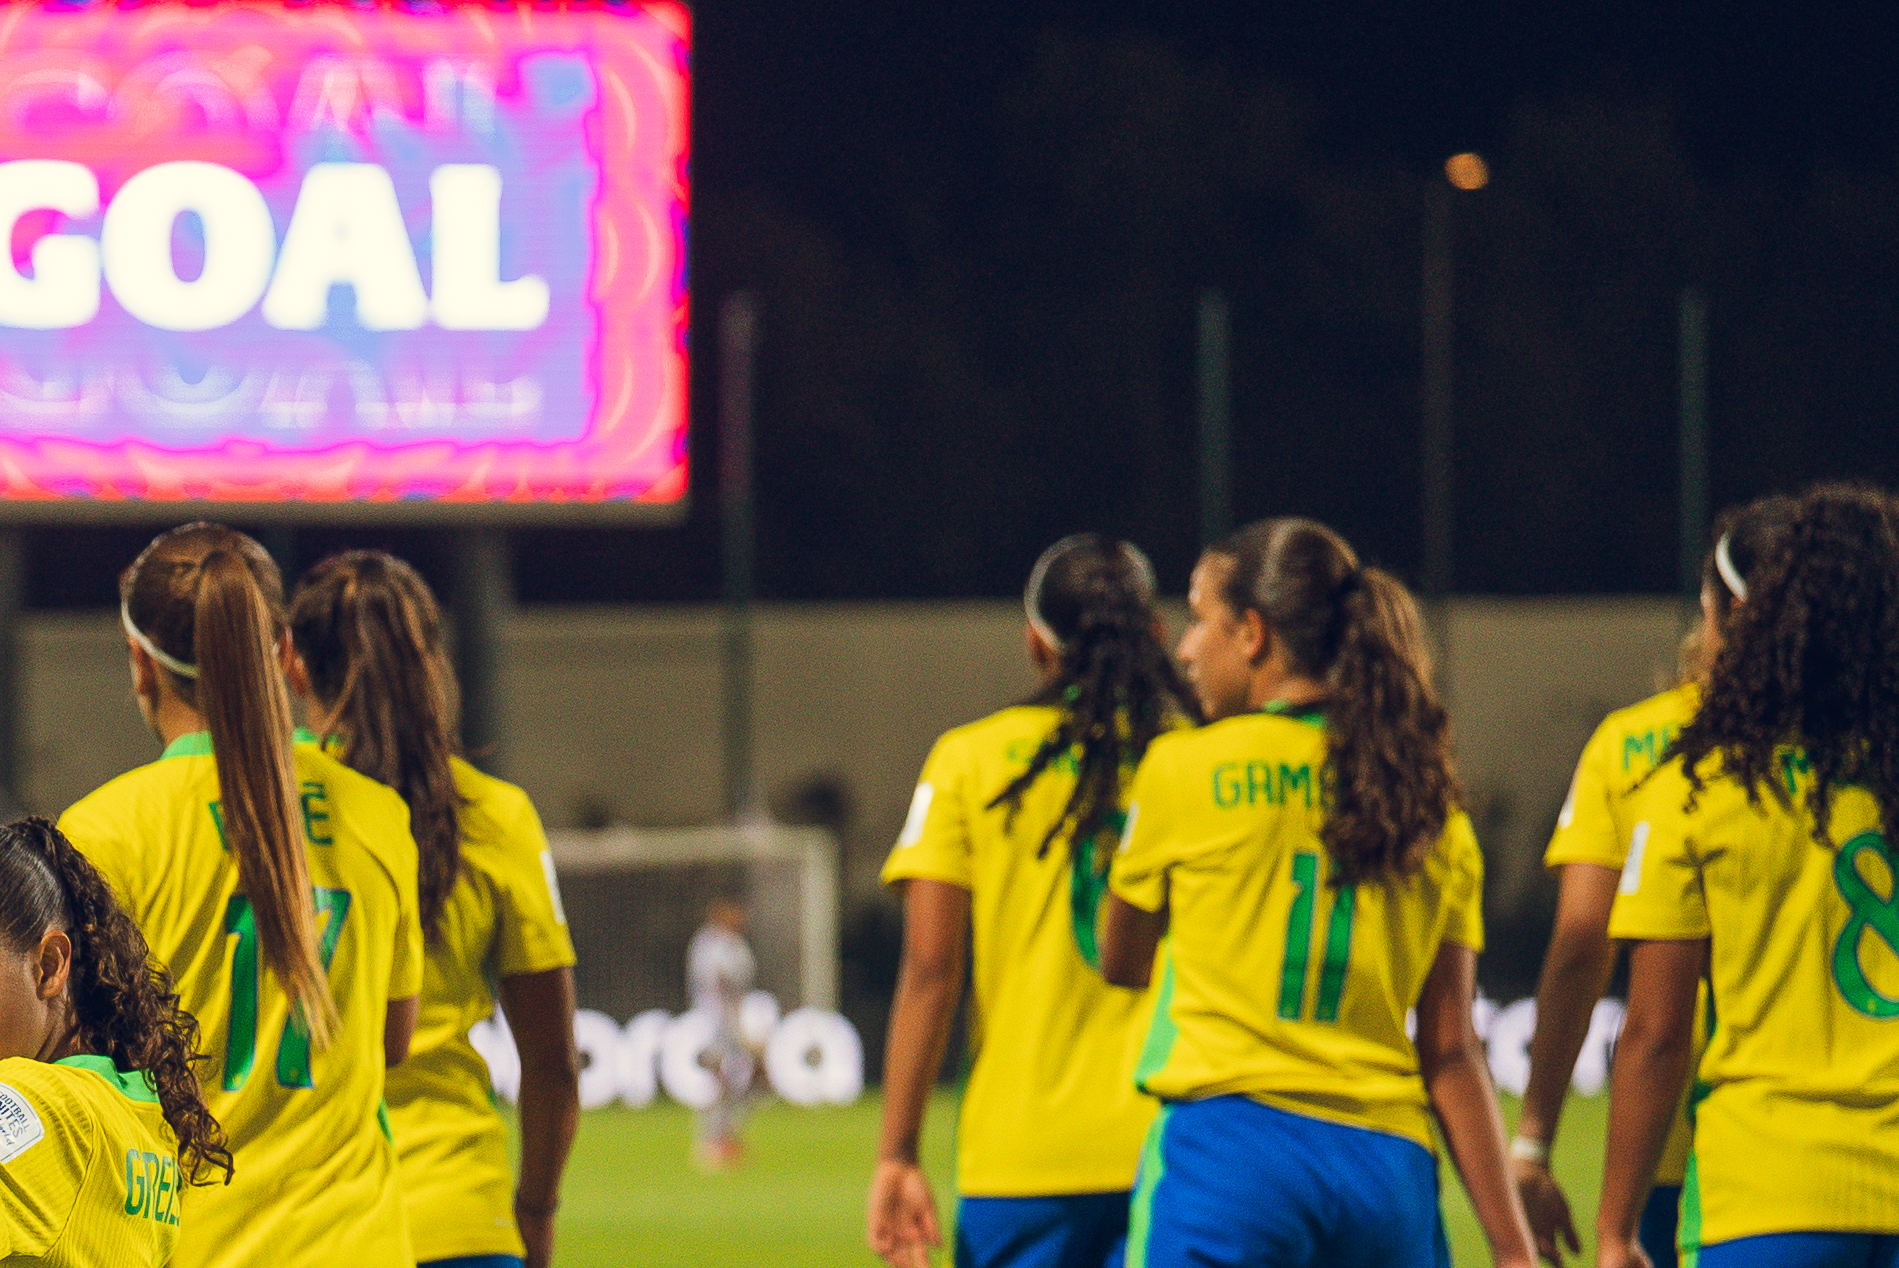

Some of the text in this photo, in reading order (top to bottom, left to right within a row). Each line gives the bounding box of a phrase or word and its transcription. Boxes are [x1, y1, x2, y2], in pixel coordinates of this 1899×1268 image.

[1212, 759, 1337, 808] GAM
[221, 886, 352, 1093] 17
[1278, 851, 1355, 1022] 11
[1831, 830, 1899, 1021] 8
